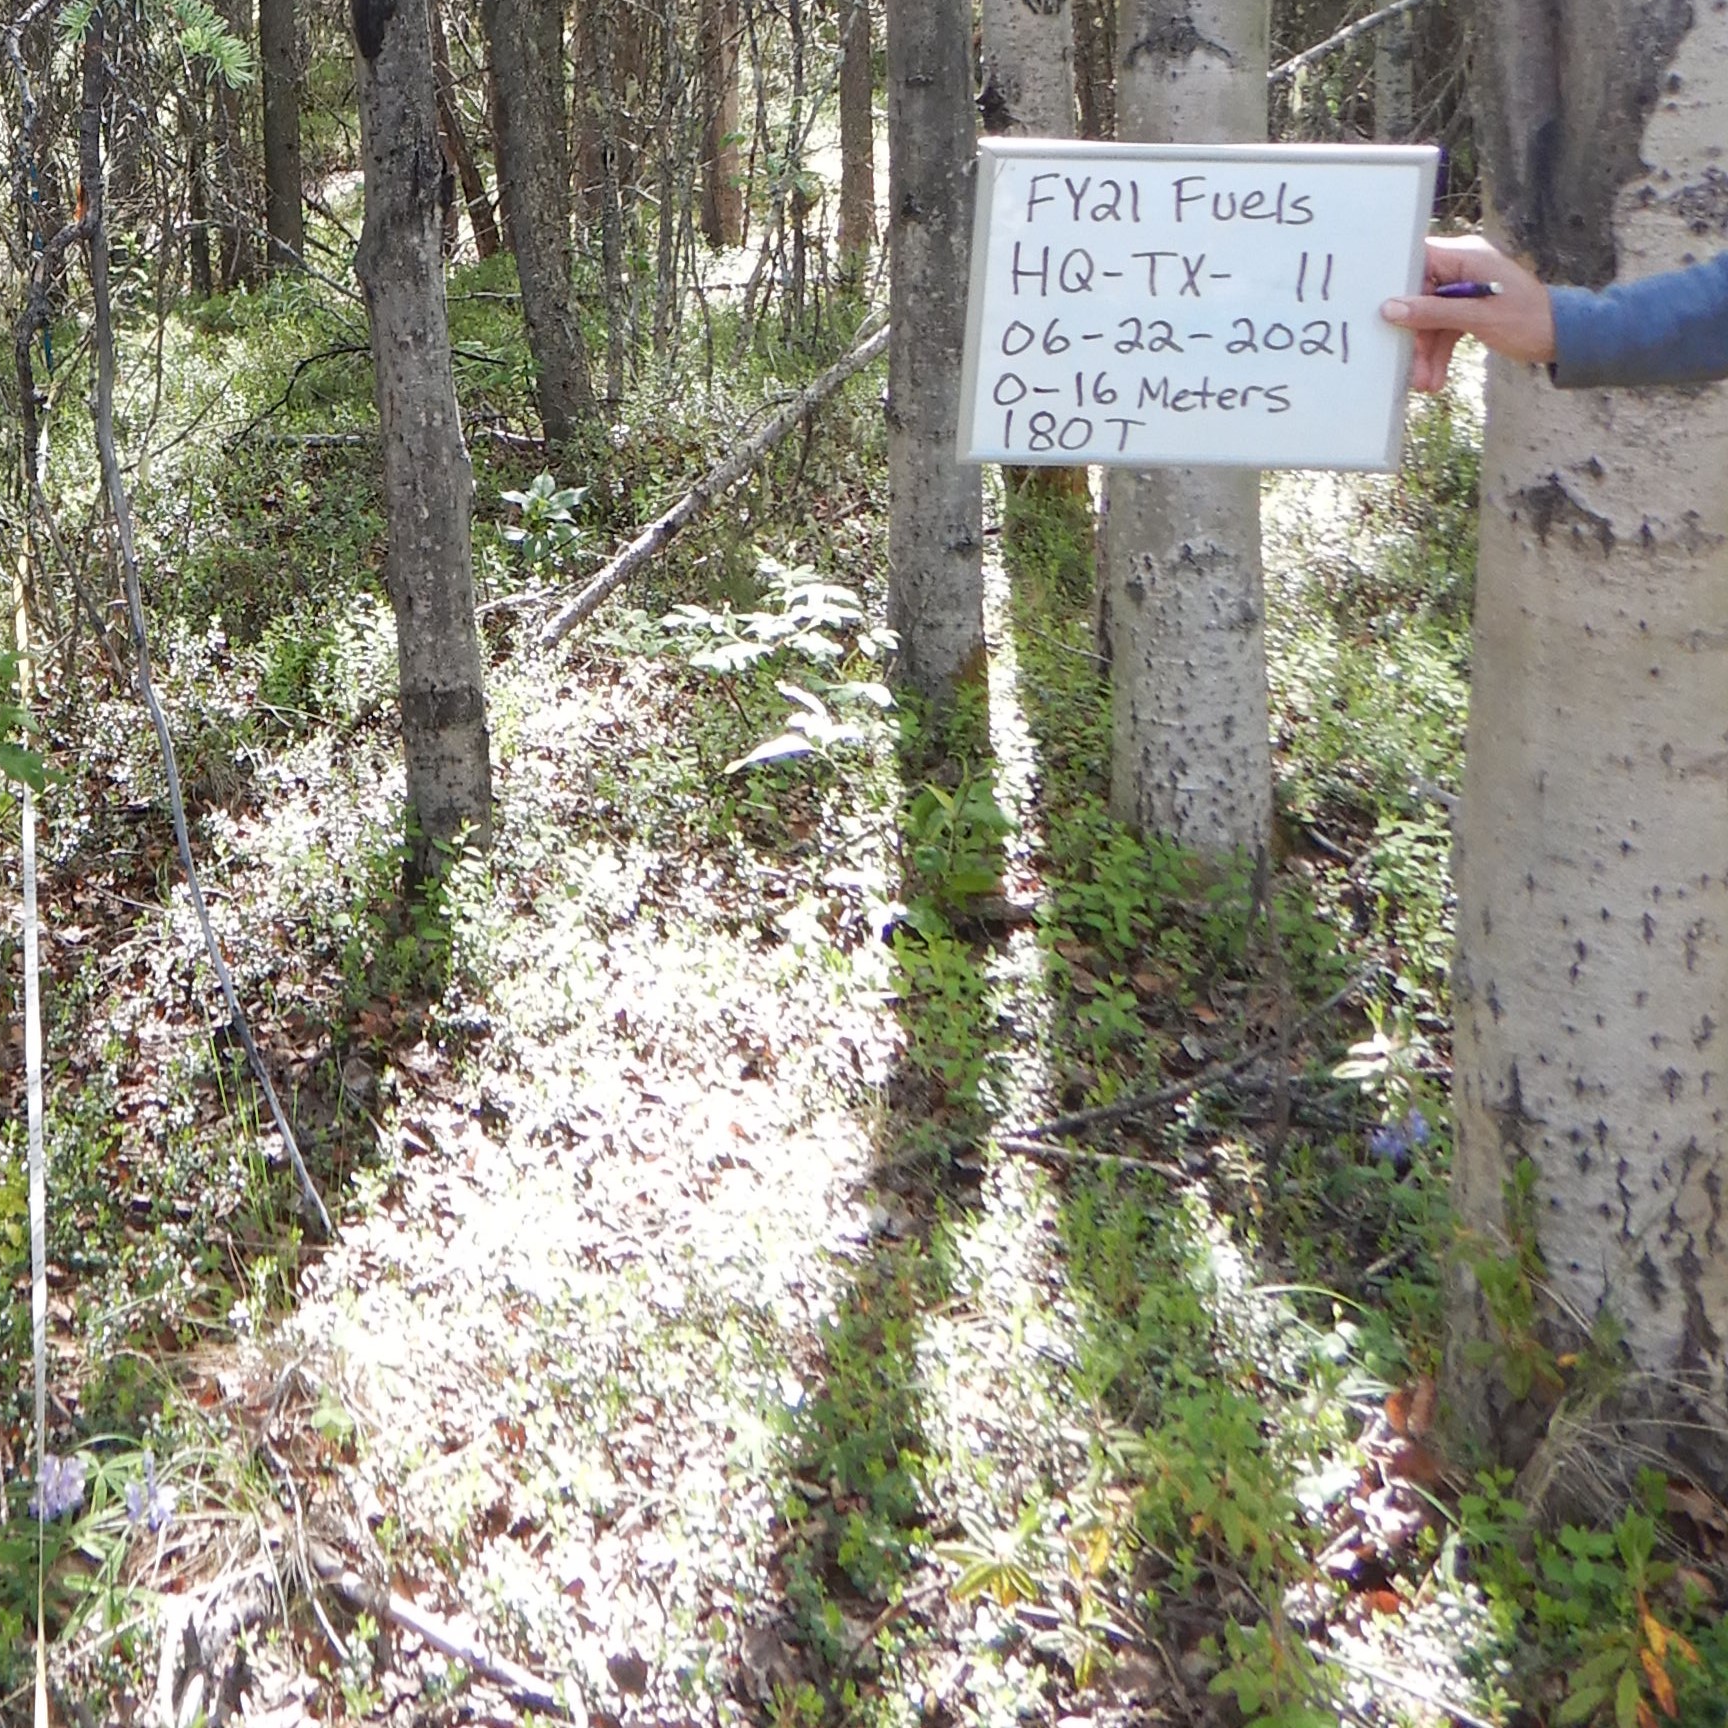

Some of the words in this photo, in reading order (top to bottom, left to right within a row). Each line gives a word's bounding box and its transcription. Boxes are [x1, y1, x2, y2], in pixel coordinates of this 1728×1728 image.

[1026, 174, 1141, 223] FY21
[1172, 175, 1315, 225] Fuels
[1011, 241, 1232, 298] HQ-TX-
[1295, 251, 1334, 303] 11
[1001, 316, 1350, 364] 06-22-2021
[992, 370, 1118, 407] 0-16
[1136, 375, 1291, 413] Meters
[1004, 408, 1147, 453] 180T
